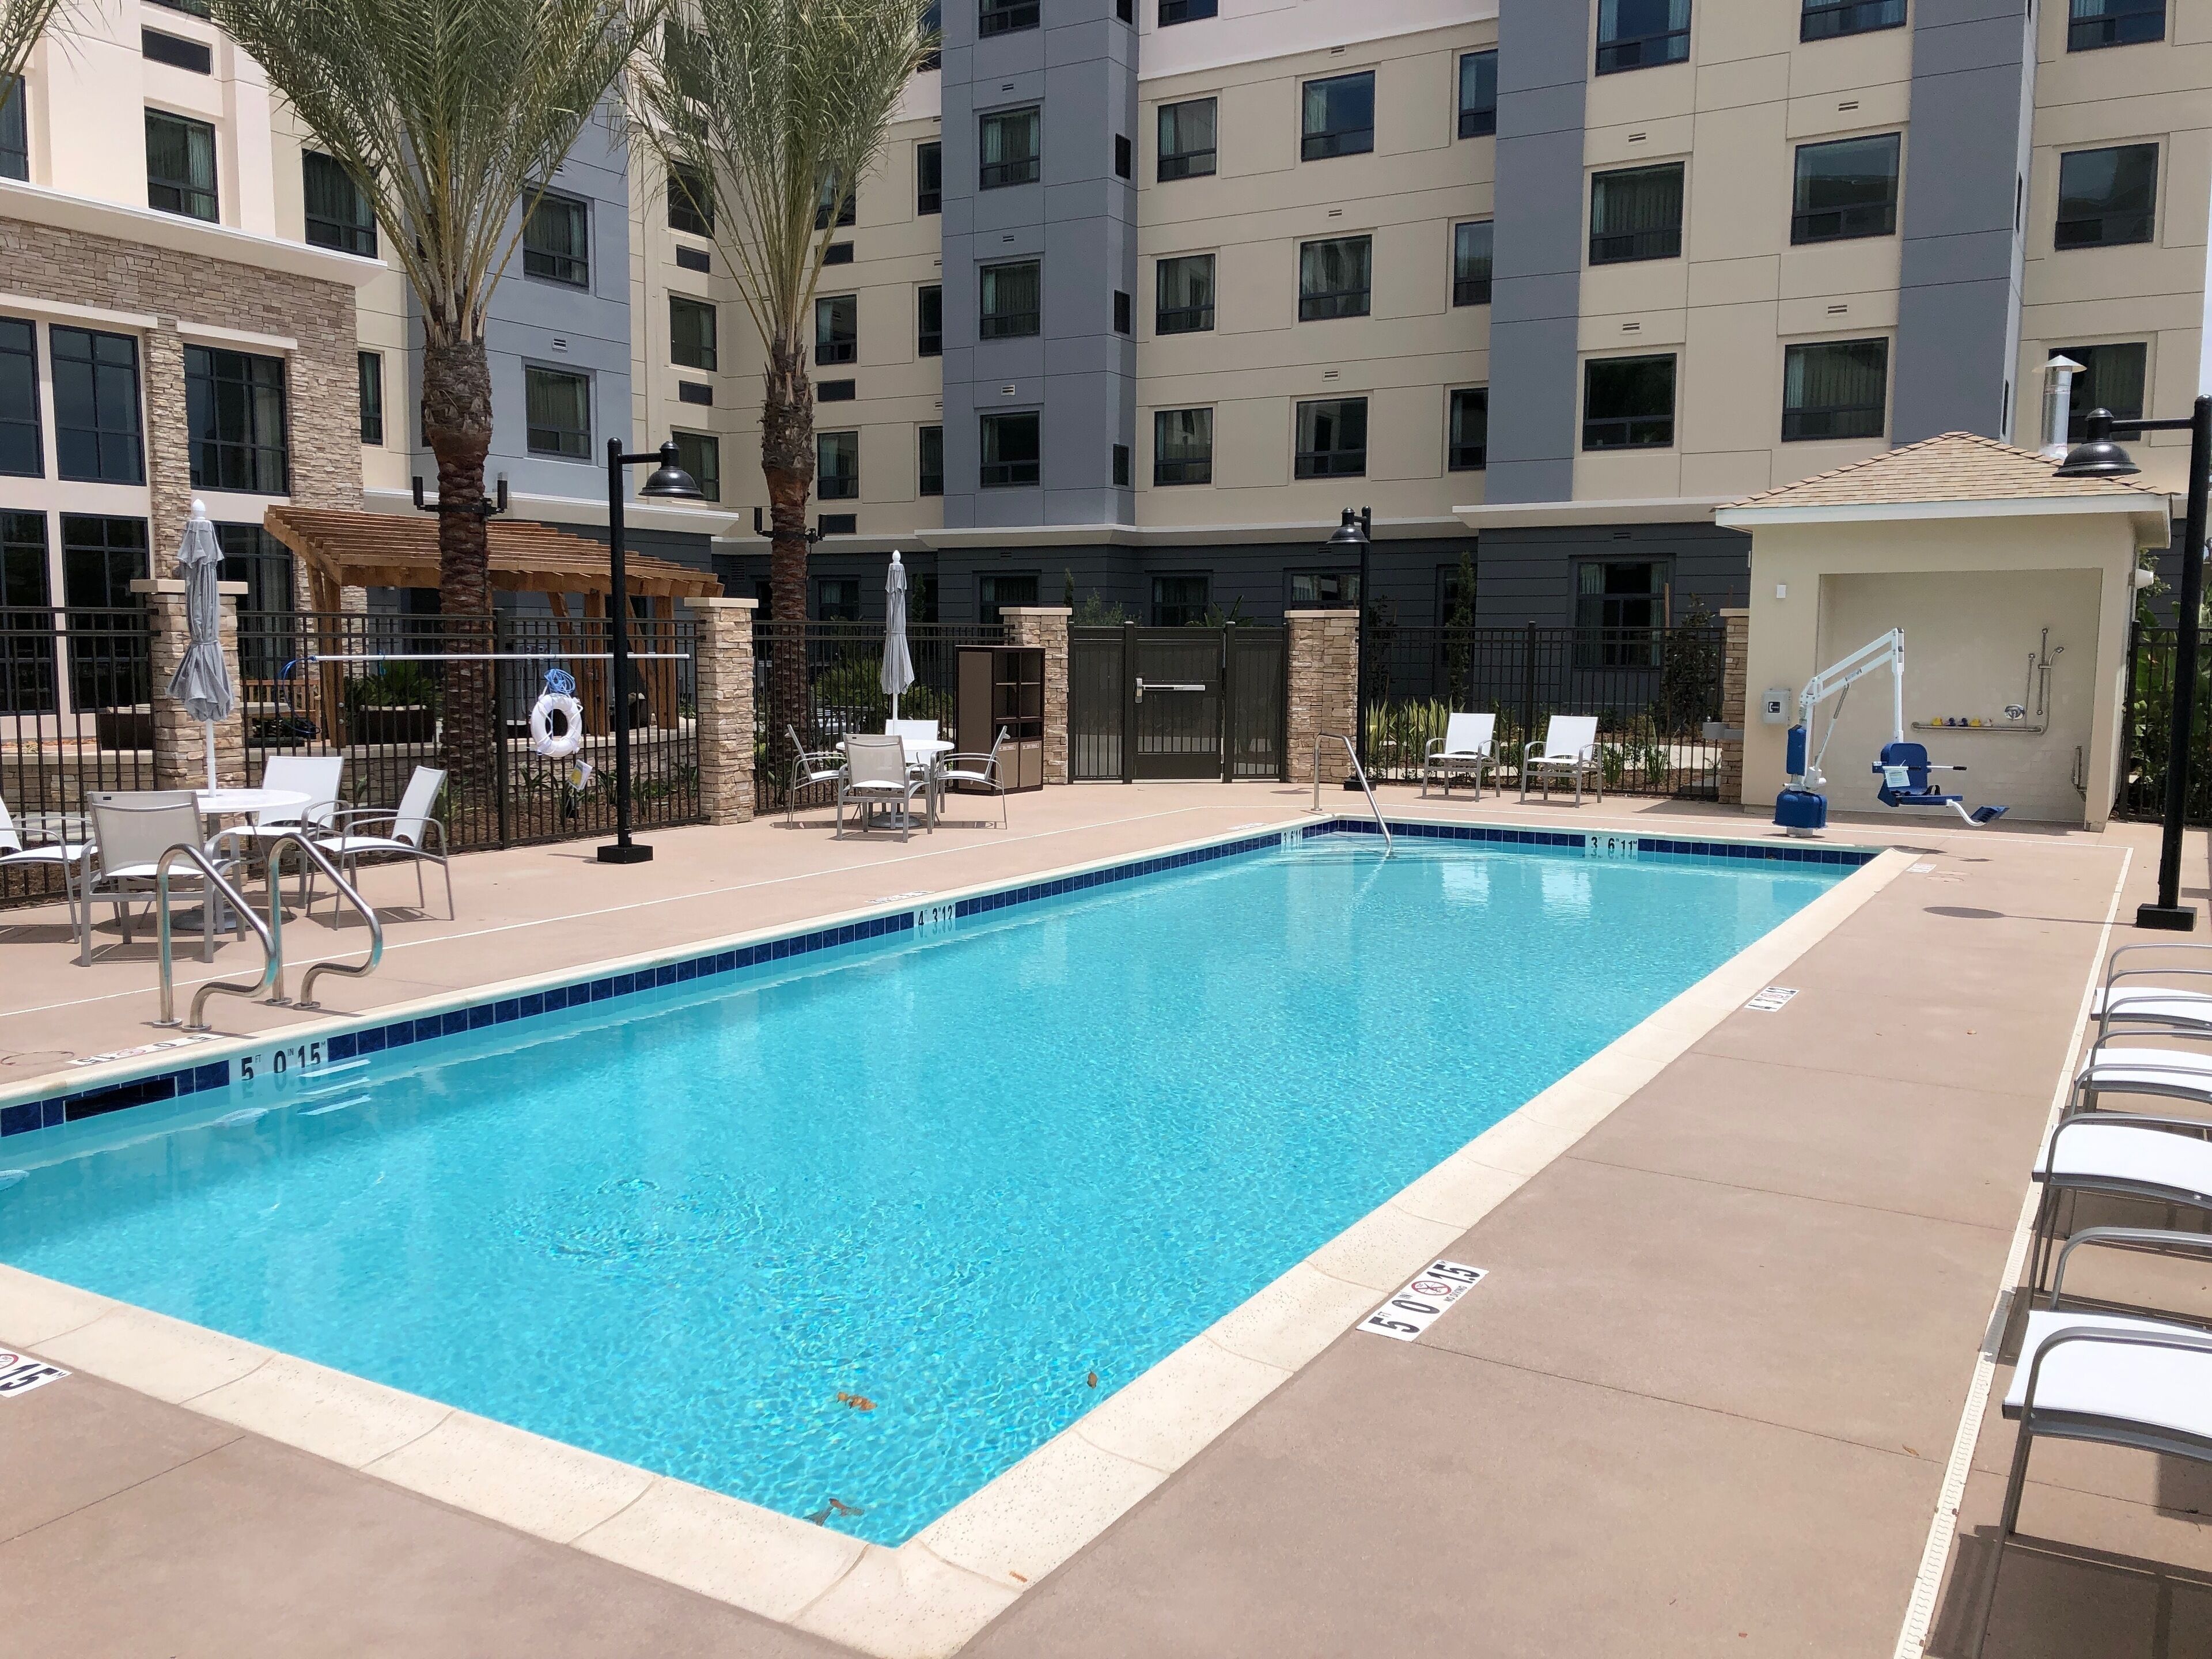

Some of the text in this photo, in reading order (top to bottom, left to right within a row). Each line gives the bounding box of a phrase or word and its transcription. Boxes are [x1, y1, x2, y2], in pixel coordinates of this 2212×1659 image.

[1591, 836, 1598, 848] 3
[1608, 838, 1615, 849] 6
[918, 910, 924, 926] 4
[932, 908, 938, 922] 3
[241, 1056, 254, 1081] 5
[255, 1054, 262, 1063] FT
[274, 1050, 286, 1074] 0
[287, 1048, 294, 1056] IN
[1449, 1285, 1468, 1297] DIVING
[1391, 1300, 1440, 1314] 0
[1368, 1316, 1420, 1334] 5
